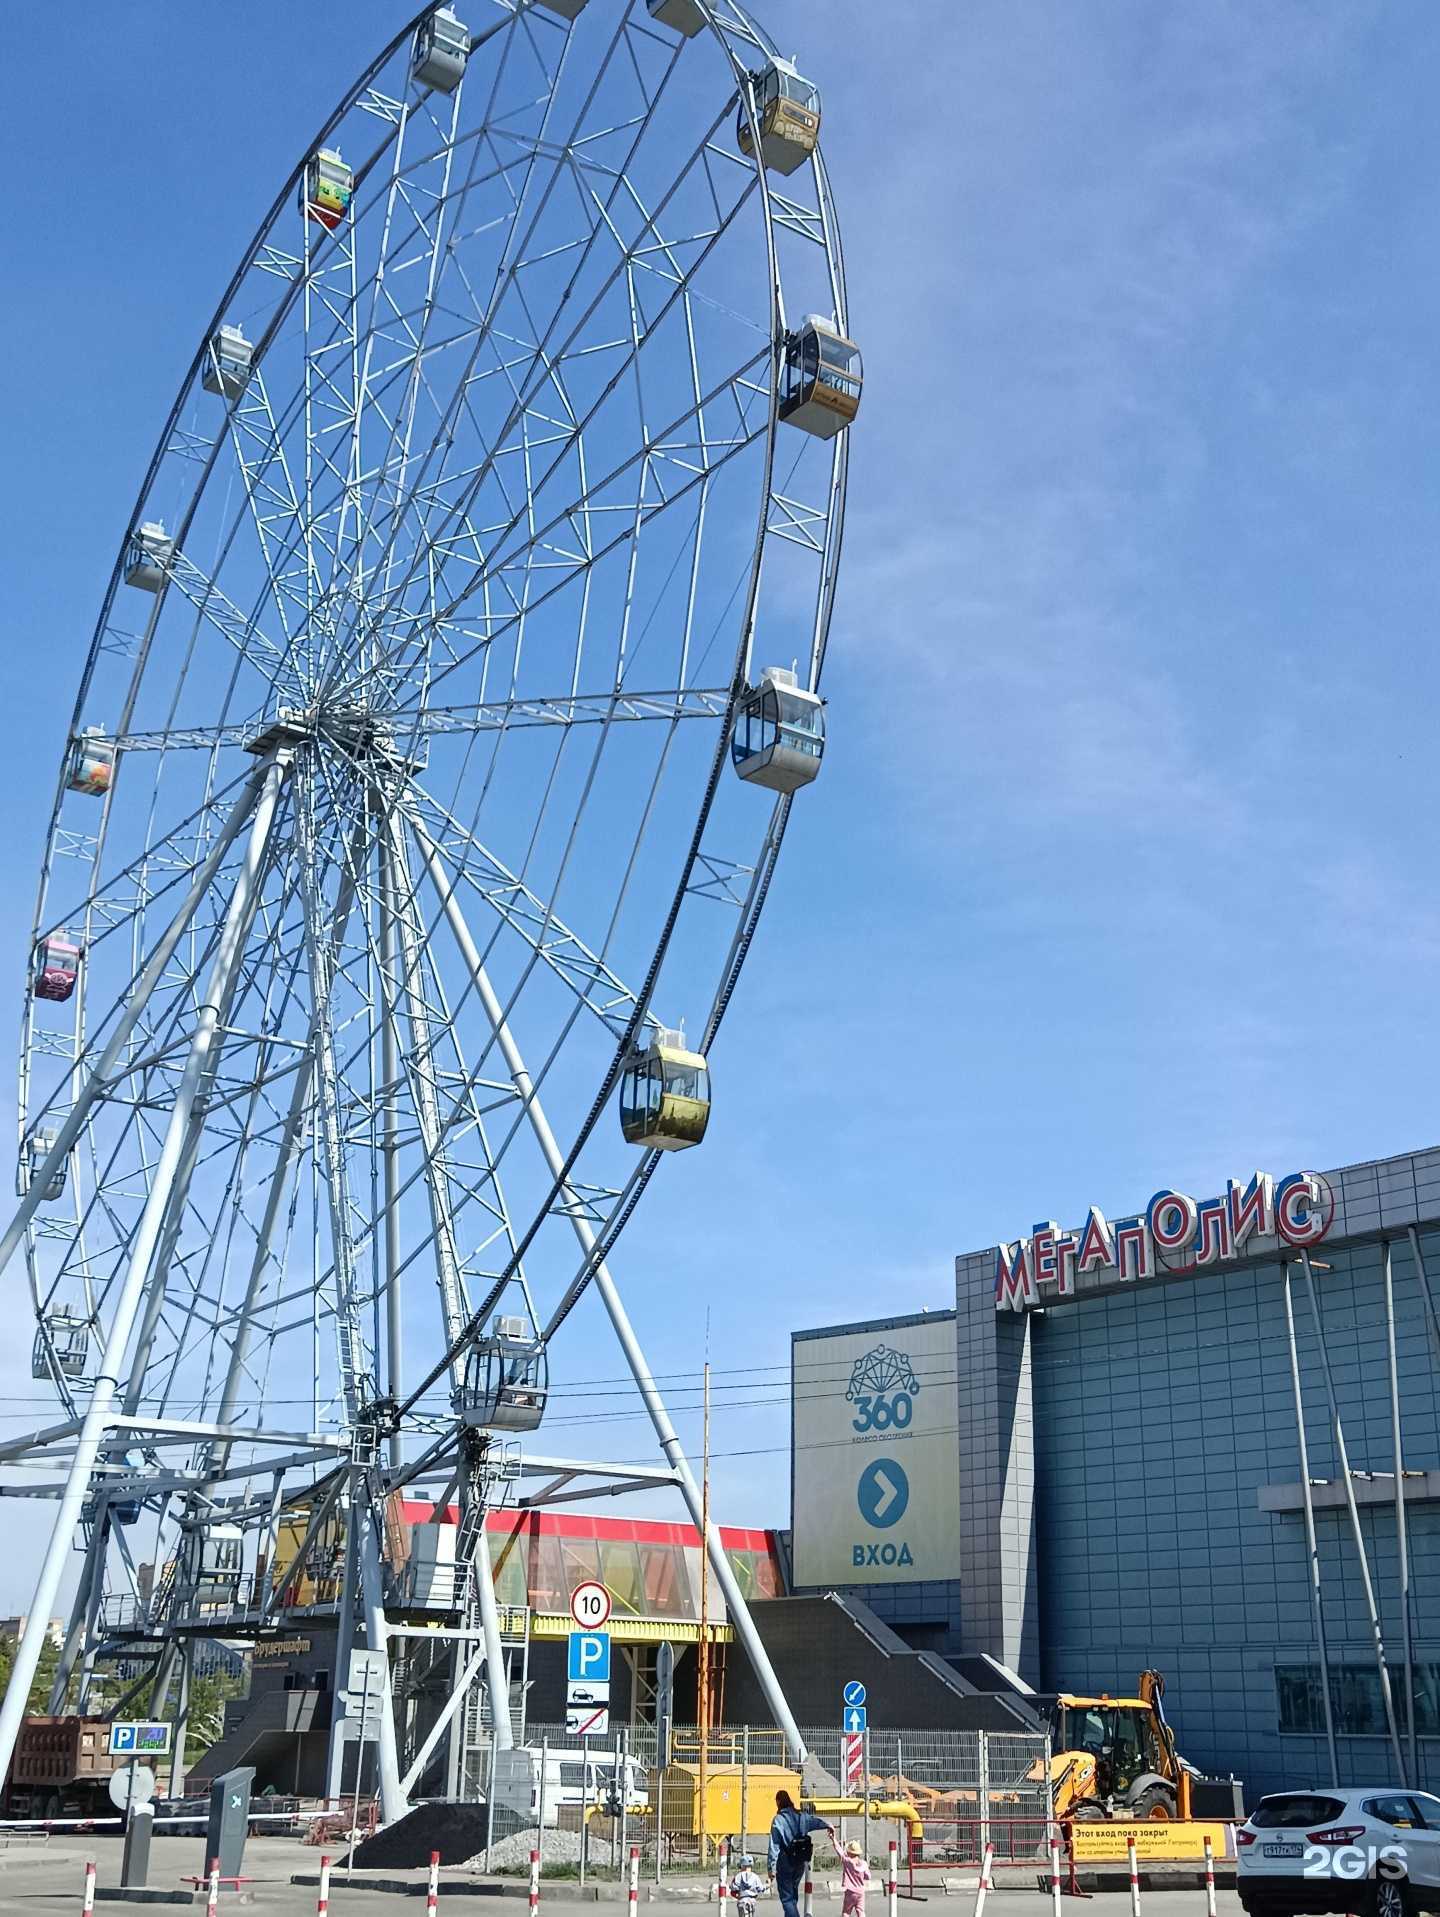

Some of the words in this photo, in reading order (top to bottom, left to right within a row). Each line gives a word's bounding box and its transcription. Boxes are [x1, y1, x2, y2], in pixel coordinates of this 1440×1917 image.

[995, 1170, 1325, 1312] МЕГАПОЛИС
[852, 1392, 913, 1433] 360
[853, 1542, 914, 1567] ВХОД
[582, 1596, 601, 1615] 10
[580, 1637, 603, 1676] P
[117, 1728, 131, 1748] P
[1076, 1829, 1094, 1838] Этот
[1096, 1829, 1116, 1838] вход
[1117, 1829, 1138, 1838] пока
[1140, 1829, 1168, 1839] закрыт
